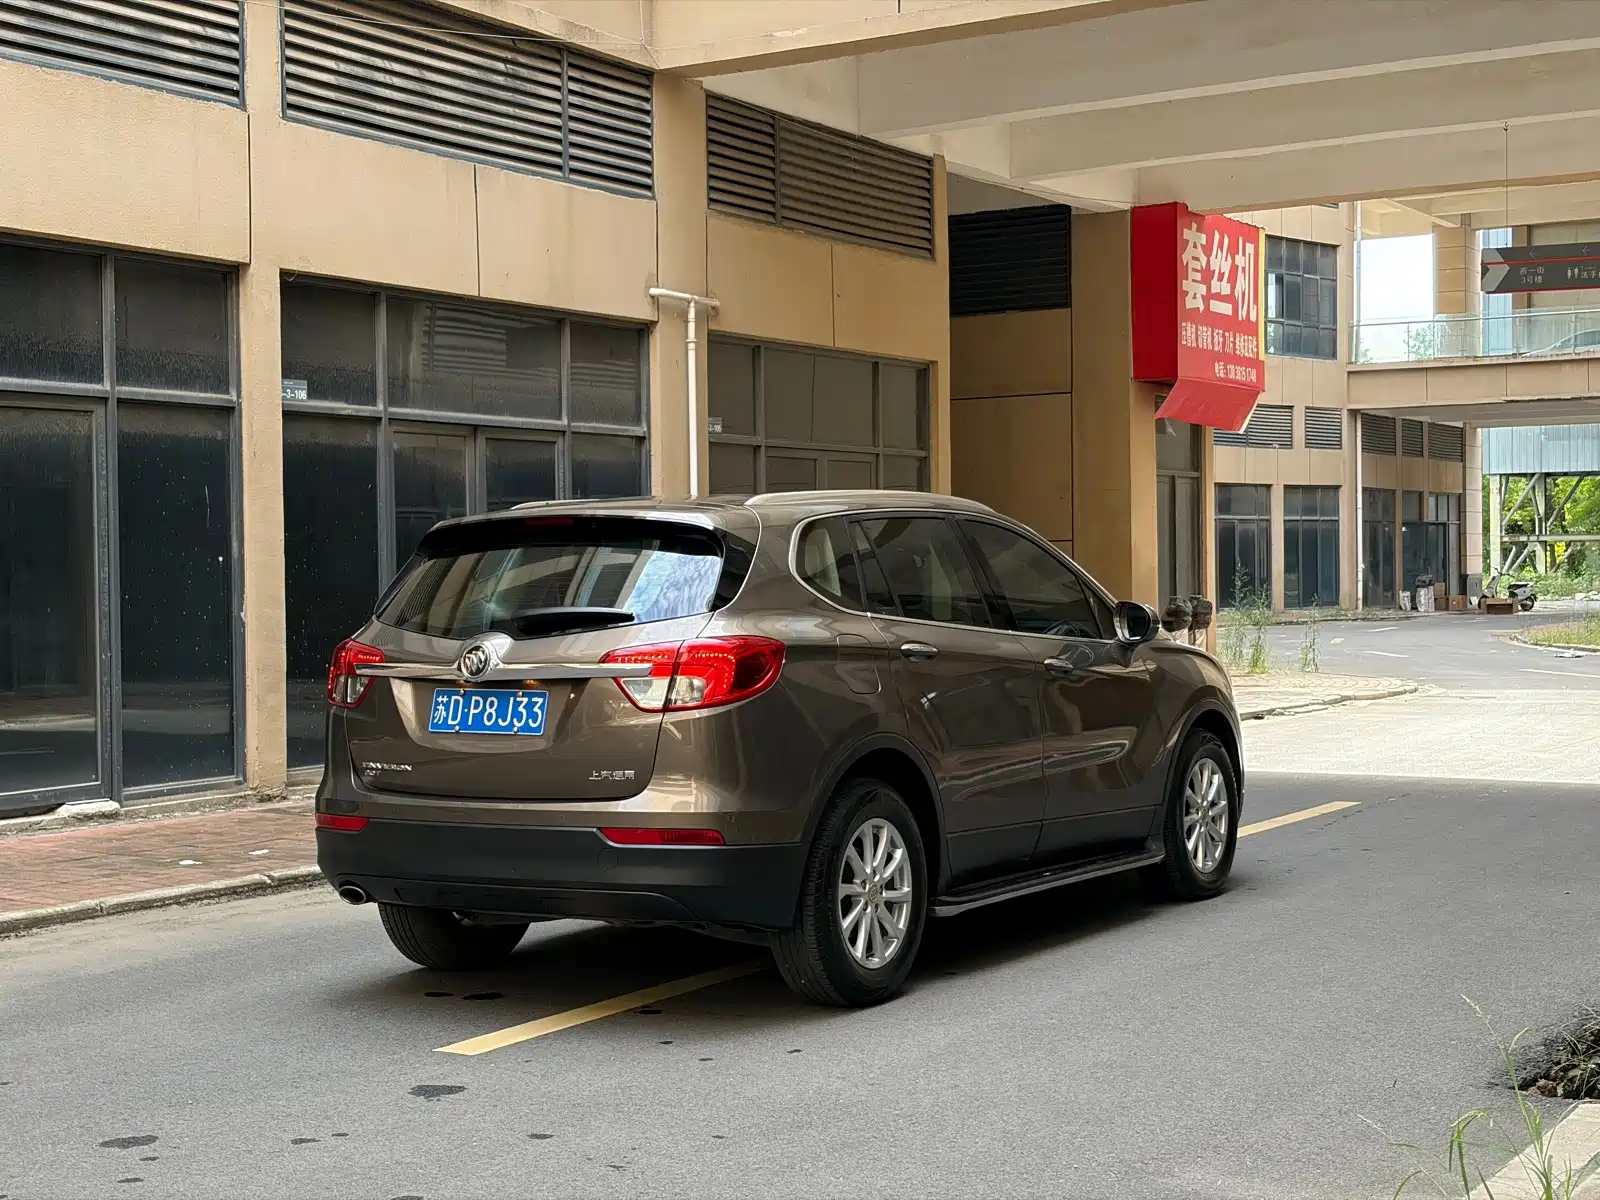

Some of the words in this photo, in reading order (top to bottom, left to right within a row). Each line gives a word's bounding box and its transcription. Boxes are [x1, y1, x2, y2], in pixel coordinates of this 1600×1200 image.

[1181, 221, 1257, 323] 套丝机
[1581, 270, 1600, 279] 洗手
